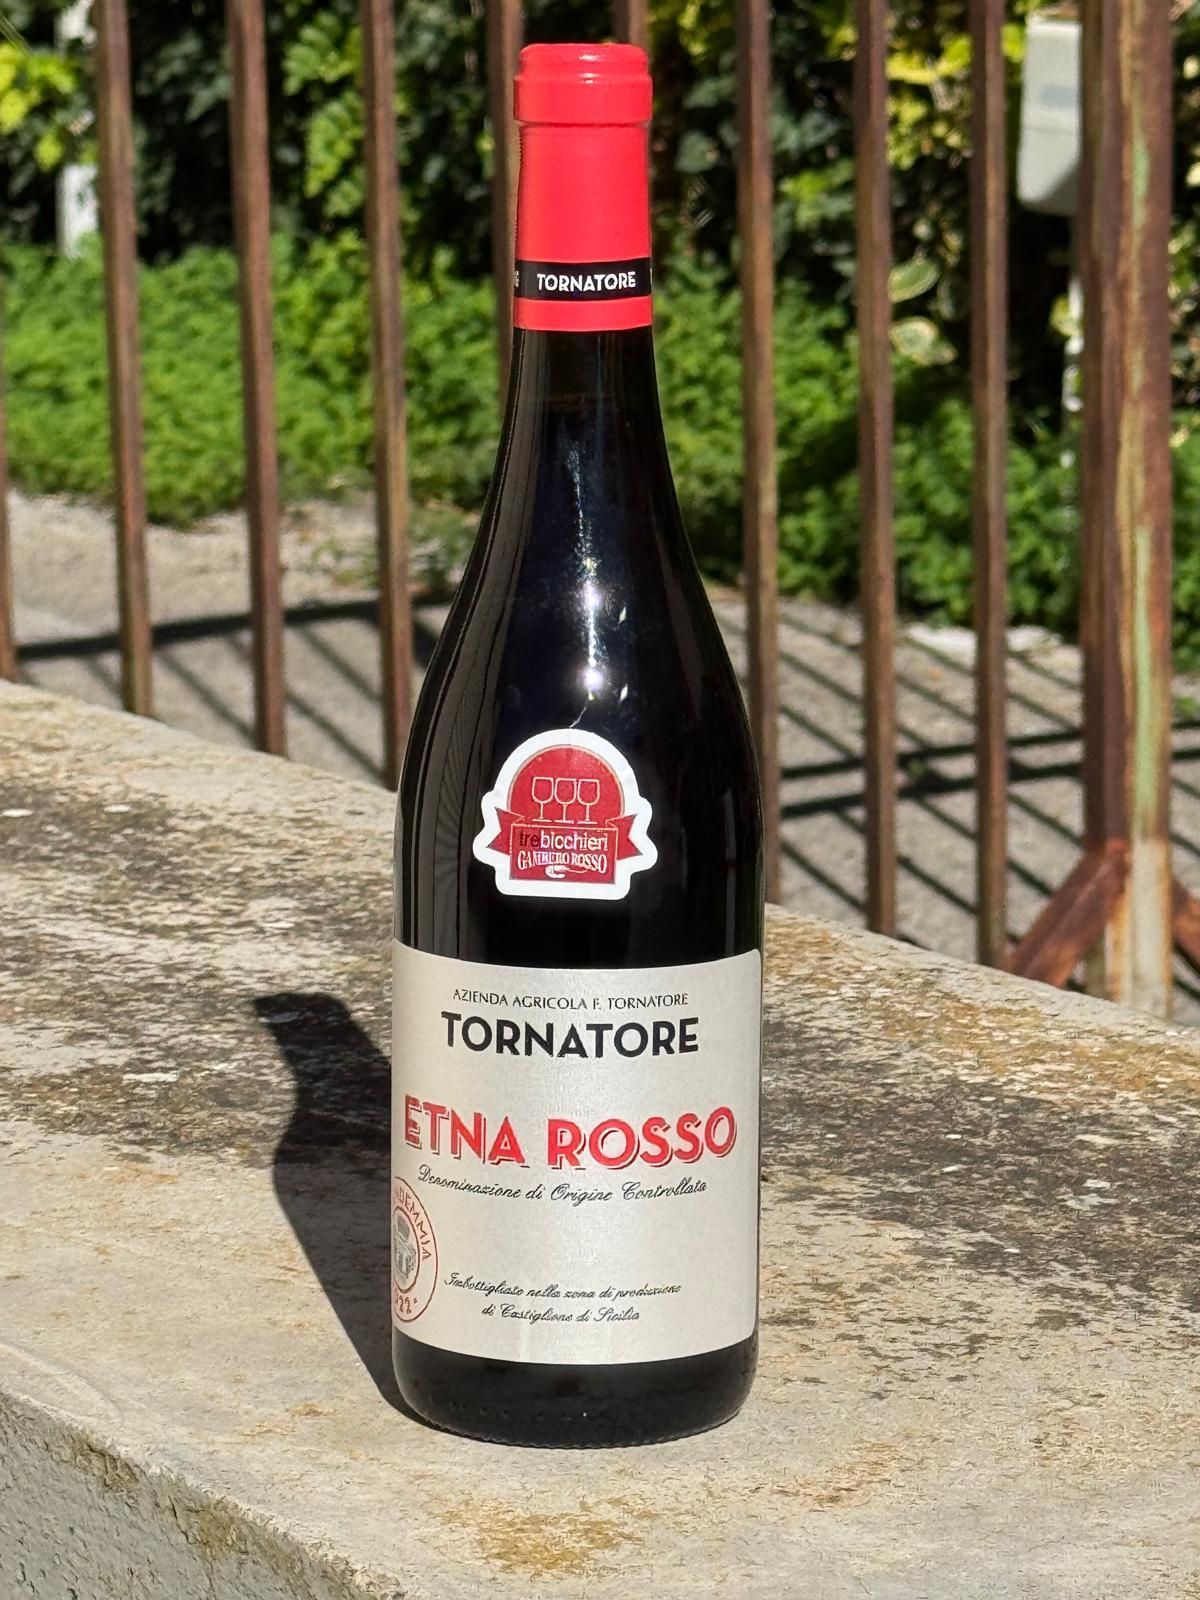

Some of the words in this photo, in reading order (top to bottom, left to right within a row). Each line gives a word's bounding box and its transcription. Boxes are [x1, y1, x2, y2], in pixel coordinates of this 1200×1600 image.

[537, 271, 636, 292] TORNATORE
[571, 852, 607, 874] ROSSO
[453, 989, 508, 1007] AZIENDA
[512, 995, 588, 1010] AGRICOLA
[608, 993, 688, 1010] TORNATORE
[441, 1010, 699, 1058] TORNATORE
[404, 1093, 530, 1169] ETNA
[547, 1106, 737, 1170] ROSSO
[418, 1164, 521, 1198] Denominazione
[525, 1184, 546, 1200] di
[550, 1183, 614, 1207] Origine
[621, 1176, 707, 1200] Controllata
[526, 1284, 561, 1298] nella
[563, 1289, 596, 1299] zona
[599, 1286, 613, 1299] di
[614, 1283, 682, 1301] produzione
[482, 1304, 496, 1317] di
[500, 1303, 572, 1325] Castiglione
[576, 1309, 589, 1322] di
[593, 1306, 640, 1322] Sicilia
